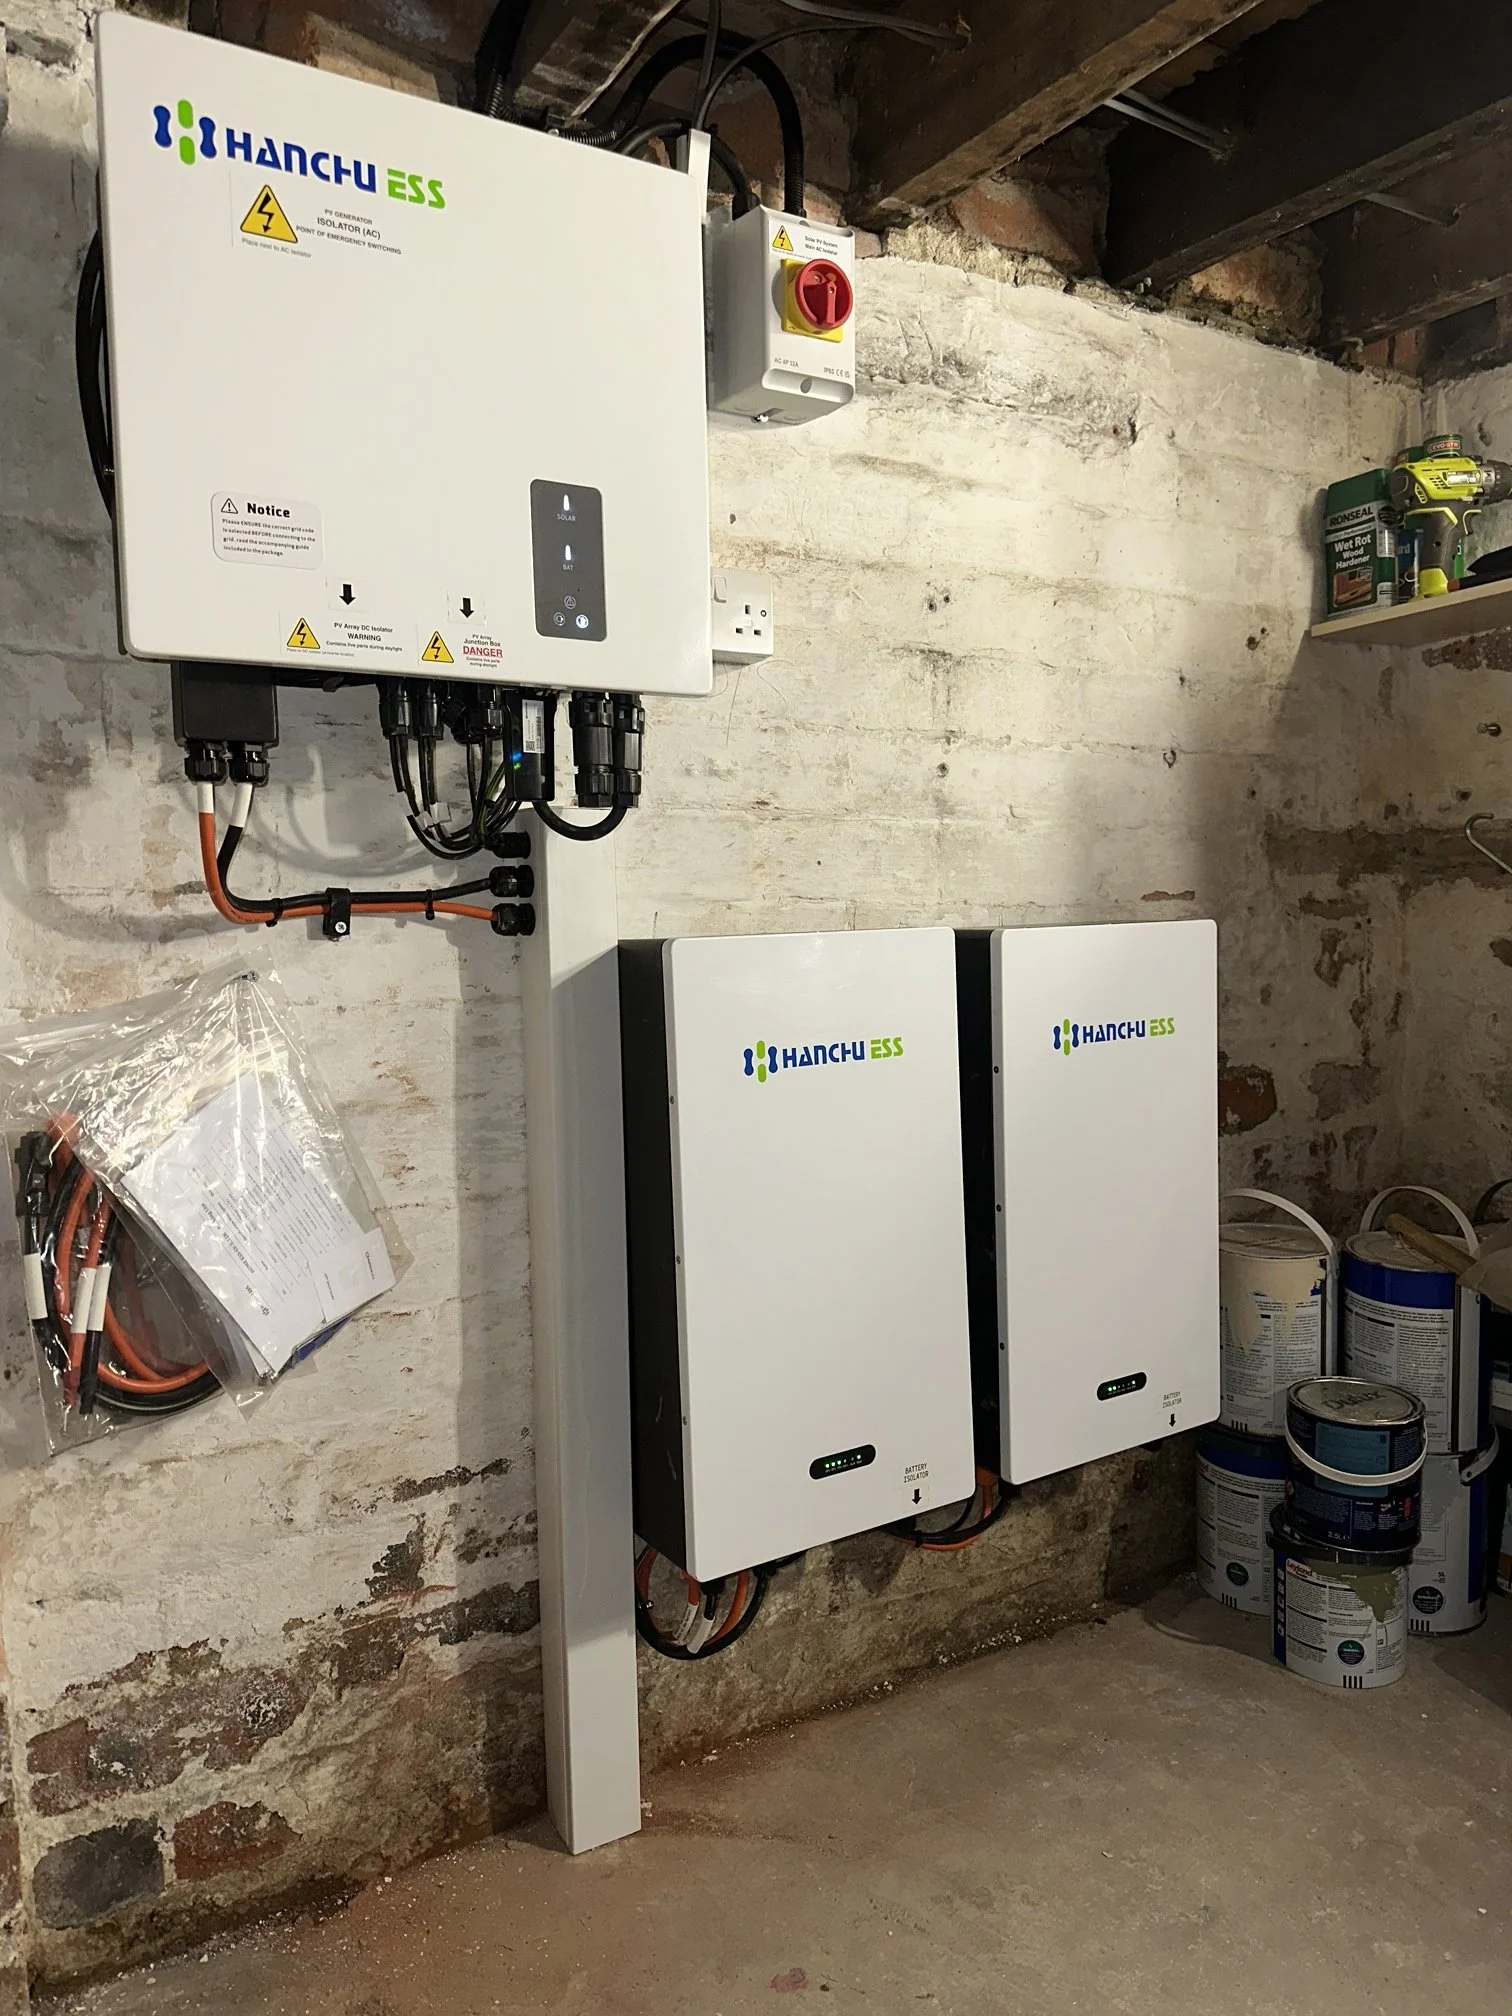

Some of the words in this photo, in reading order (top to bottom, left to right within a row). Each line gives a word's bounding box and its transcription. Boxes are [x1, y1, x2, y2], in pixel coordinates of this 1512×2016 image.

[226, 128, 376, 194] HANCHU
[387, 168, 446, 209] ESS
[324, 208, 333, 216] PV
[334, 211, 372, 225] GENERATOR
[317, 217, 360, 234] ISOLATOR
[362, 228, 381, 240] (AC)
[296, 225, 315, 235] POINT
[327, 233, 366, 247] EMERGENCY
[368, 242, 402, 255] SWITCHING
[247, 502, 290, 518] Notice
[1330, 506, 1373, 526] RONSEAL
[1334, 540, 1353, 552] Wet
[1355, 534, 1371, 546] Rot
[1343, 546, 1364, 559] Wood
[1336, 555, 1370, 569] Hardener
[348, 633, 381, 641] WARNING
[463, 646, 503, 658] DANGER
[1083, 1020, 1146, 1043] HANCHU
[1150, 1018, 1175, 1036] ESS
[782, 1040, 865, 1068] HANCHU
[870, 1037, 904, 1059] ESS
[1162, 1398, 1182, 1408] ISOLATOR
[1164, 1391, 1181, 1400] BATTERY
[905, 1462, 927, 1474] BATTERY
[904, 1471, 929, 1483] ISOLATOR
